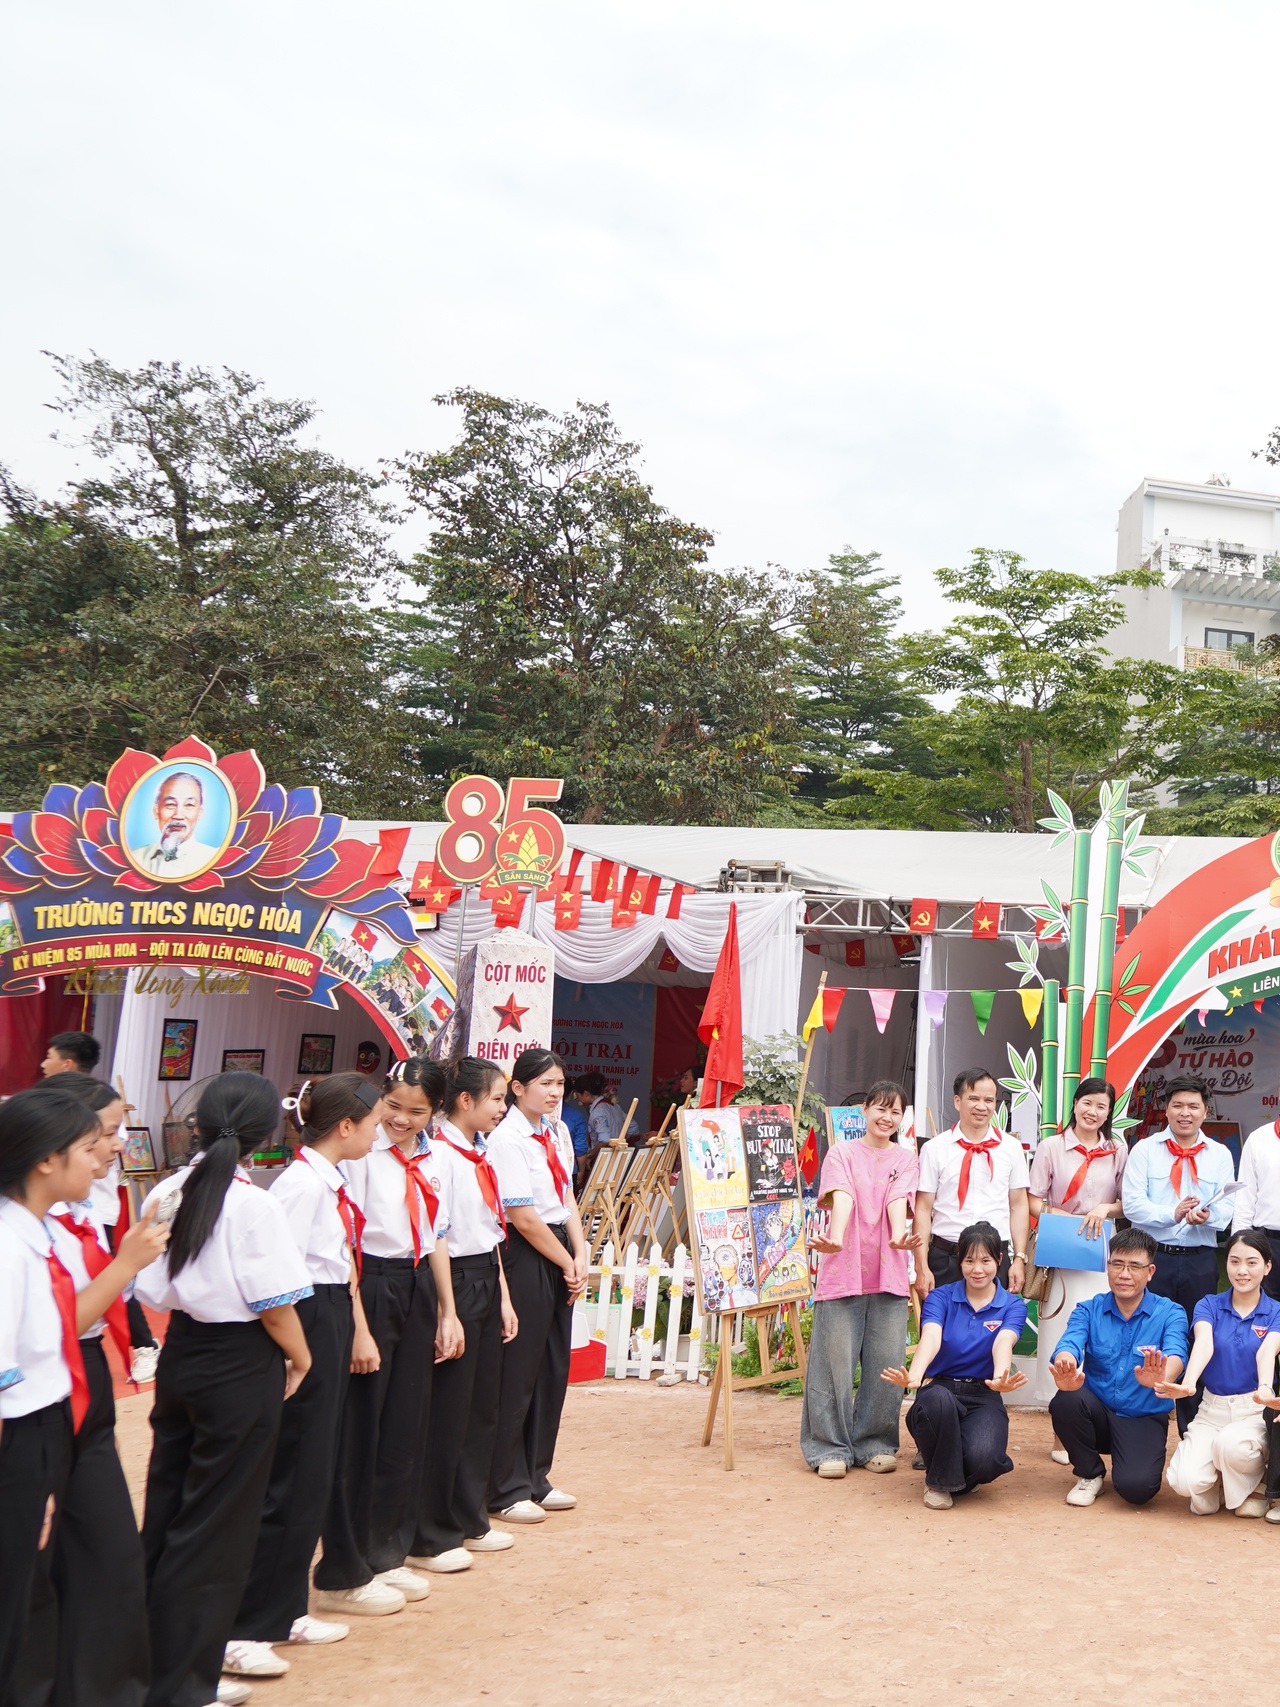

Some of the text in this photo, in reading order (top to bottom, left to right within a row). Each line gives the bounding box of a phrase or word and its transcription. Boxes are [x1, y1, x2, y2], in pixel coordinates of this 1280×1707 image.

[436, 775, 567, 884] 85
[523, 872, 546, 882] SÀNG
[33, 898, 303, 934] TRƯỜNG THCS NGỌC HÒA
[12, 949, 30, 971] KỶ
[32, 946, 64, 968] NIỆM
[67, 946, 82, 962] 85
[85, 942, 111, 960] MÙA
[113, 943, 137, 958] HOA
[149, 940, 169, 959] ĐỘI
[171, 943, 185, 957] TA
[187, 940, 209, 959] LỚN
[211, 940, 233, 962] LÊN
[234, 946, 263, 966] CÙNG
[264, 948, 284, 969] ĐẤT
[284, 955, 314, 978] NƯỚC
[484, 957, 546, 985] CỘT MỐC
[132, 964, 184, 1008] Vọng
[190, 965, 250, 996] Xanh
[1253, 976, 1280, 993] LIÊN
[552, 1019, 573, 1027] RƯỜNG
[592, 1020, 608, 1029] NGỌC
[610, 1021, 624, 1029] HÒA
[1184, 1030, 1217, 1046] mùa
[1217, 1029, 1247, 1045] hoa
[477, 1038, 509, 1060] BIÊN
[551, 1037, 633, 1062] ỘI TRẠI
[573, 1064, 582, 1072] 85
[602, 1065, 625, 1074] THÀNH
[626, 1066, 640, 1076] LẬP
[1178, 1049, 1254, 1072] TỰ HÀO
[1220, 1069, 1254, 1091] Đội
[1262, 1096, 1279, 1109] ĐỘI
[757, 1125, 781, 1138] STOP
